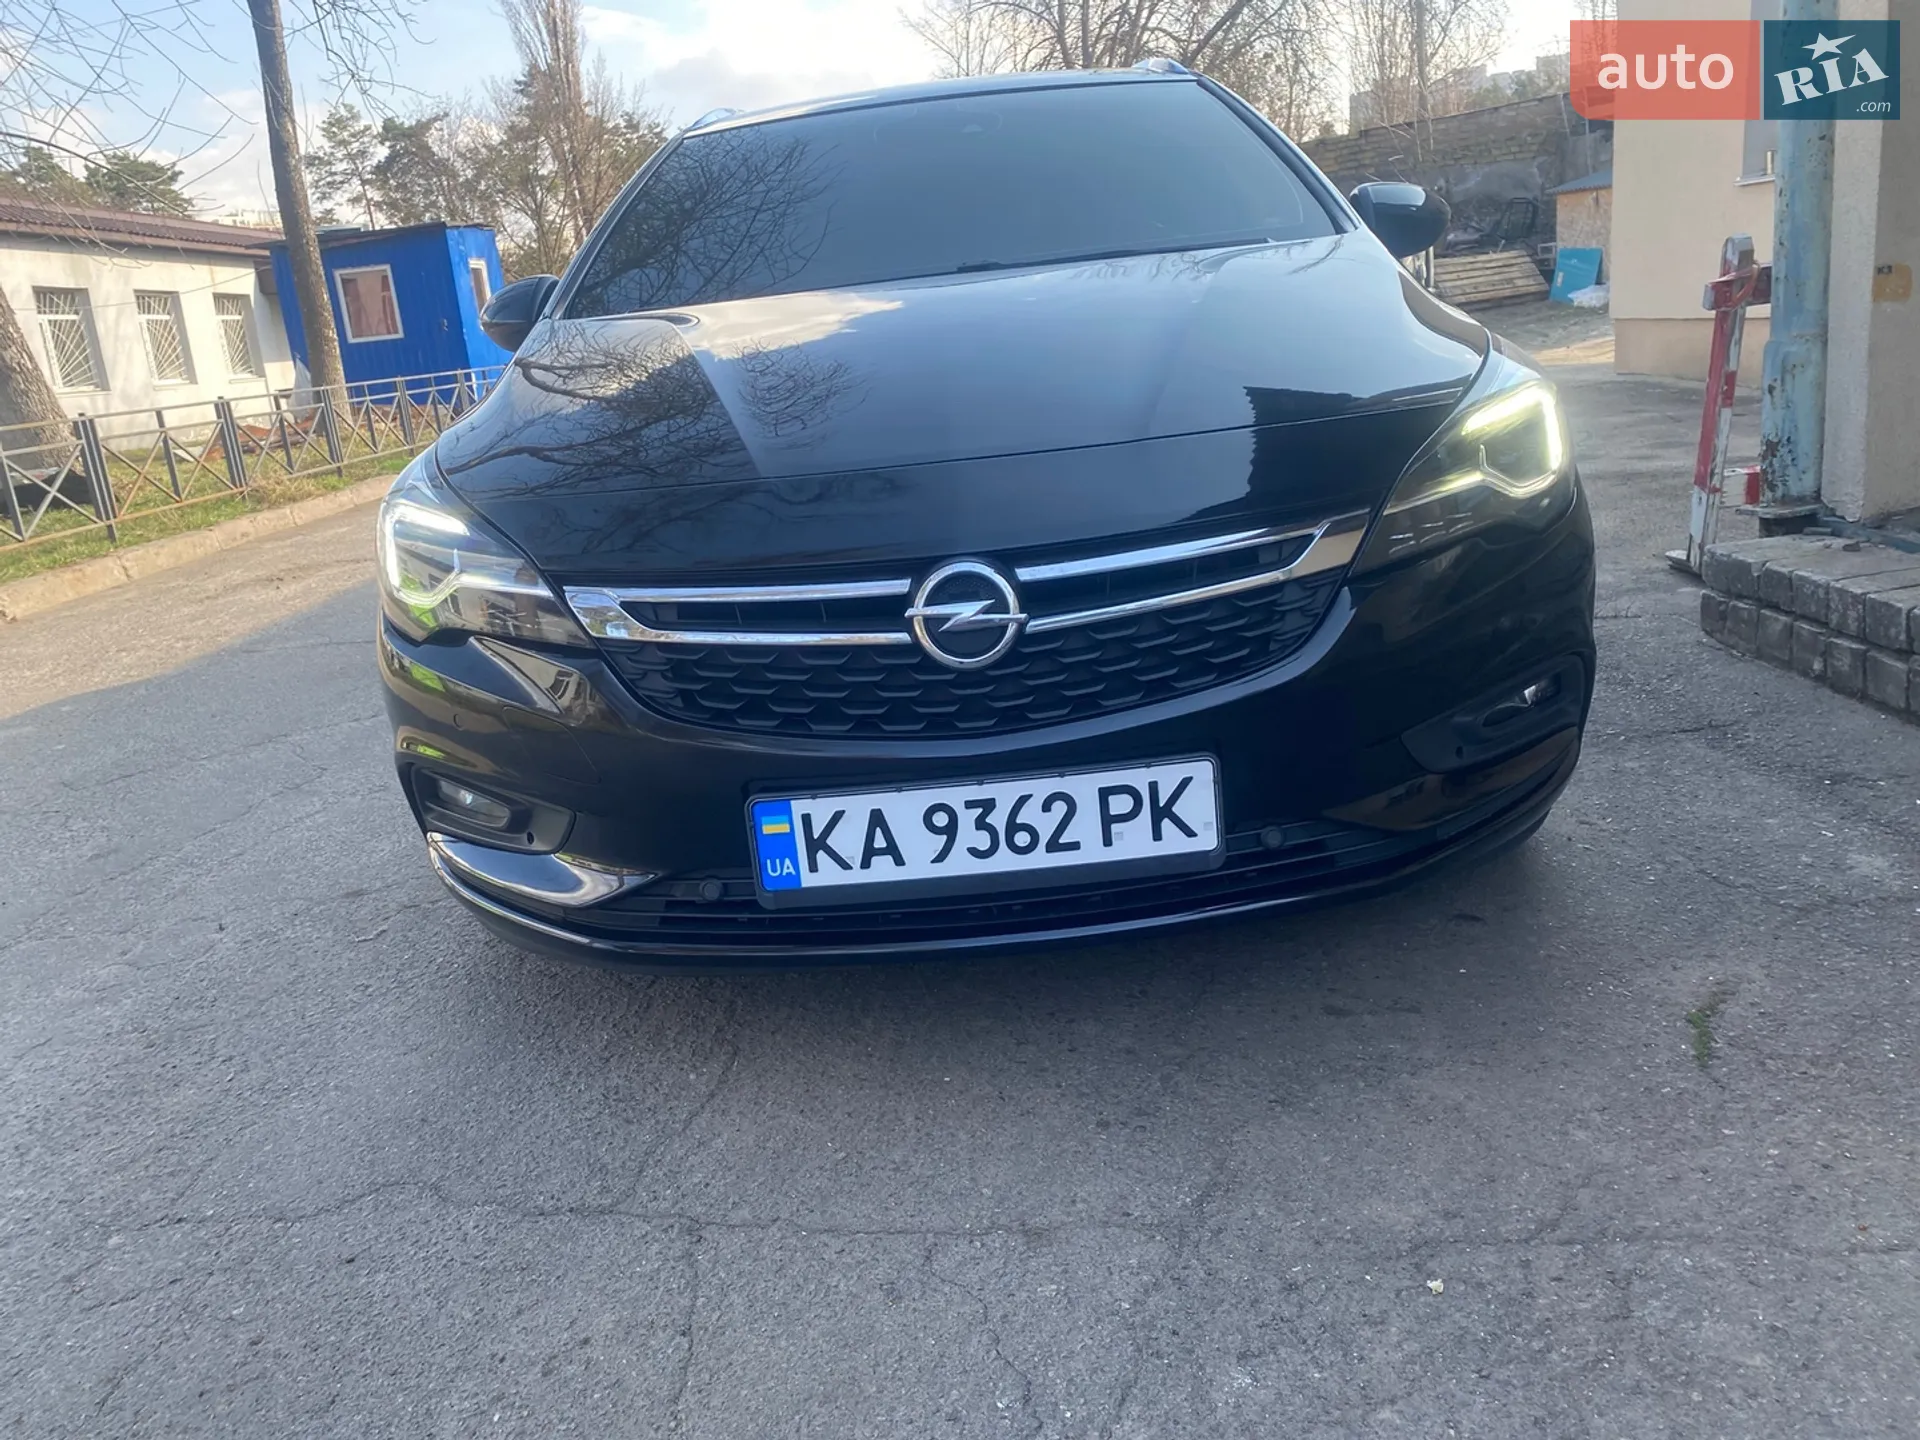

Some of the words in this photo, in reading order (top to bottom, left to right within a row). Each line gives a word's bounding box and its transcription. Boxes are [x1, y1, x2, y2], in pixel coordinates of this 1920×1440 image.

[801, 808, 906, 873] KA
[922, 791, 1081, 864] 9362
[1097, 775, 1198, 848] PK
[766, 857, 796, 877] UA
